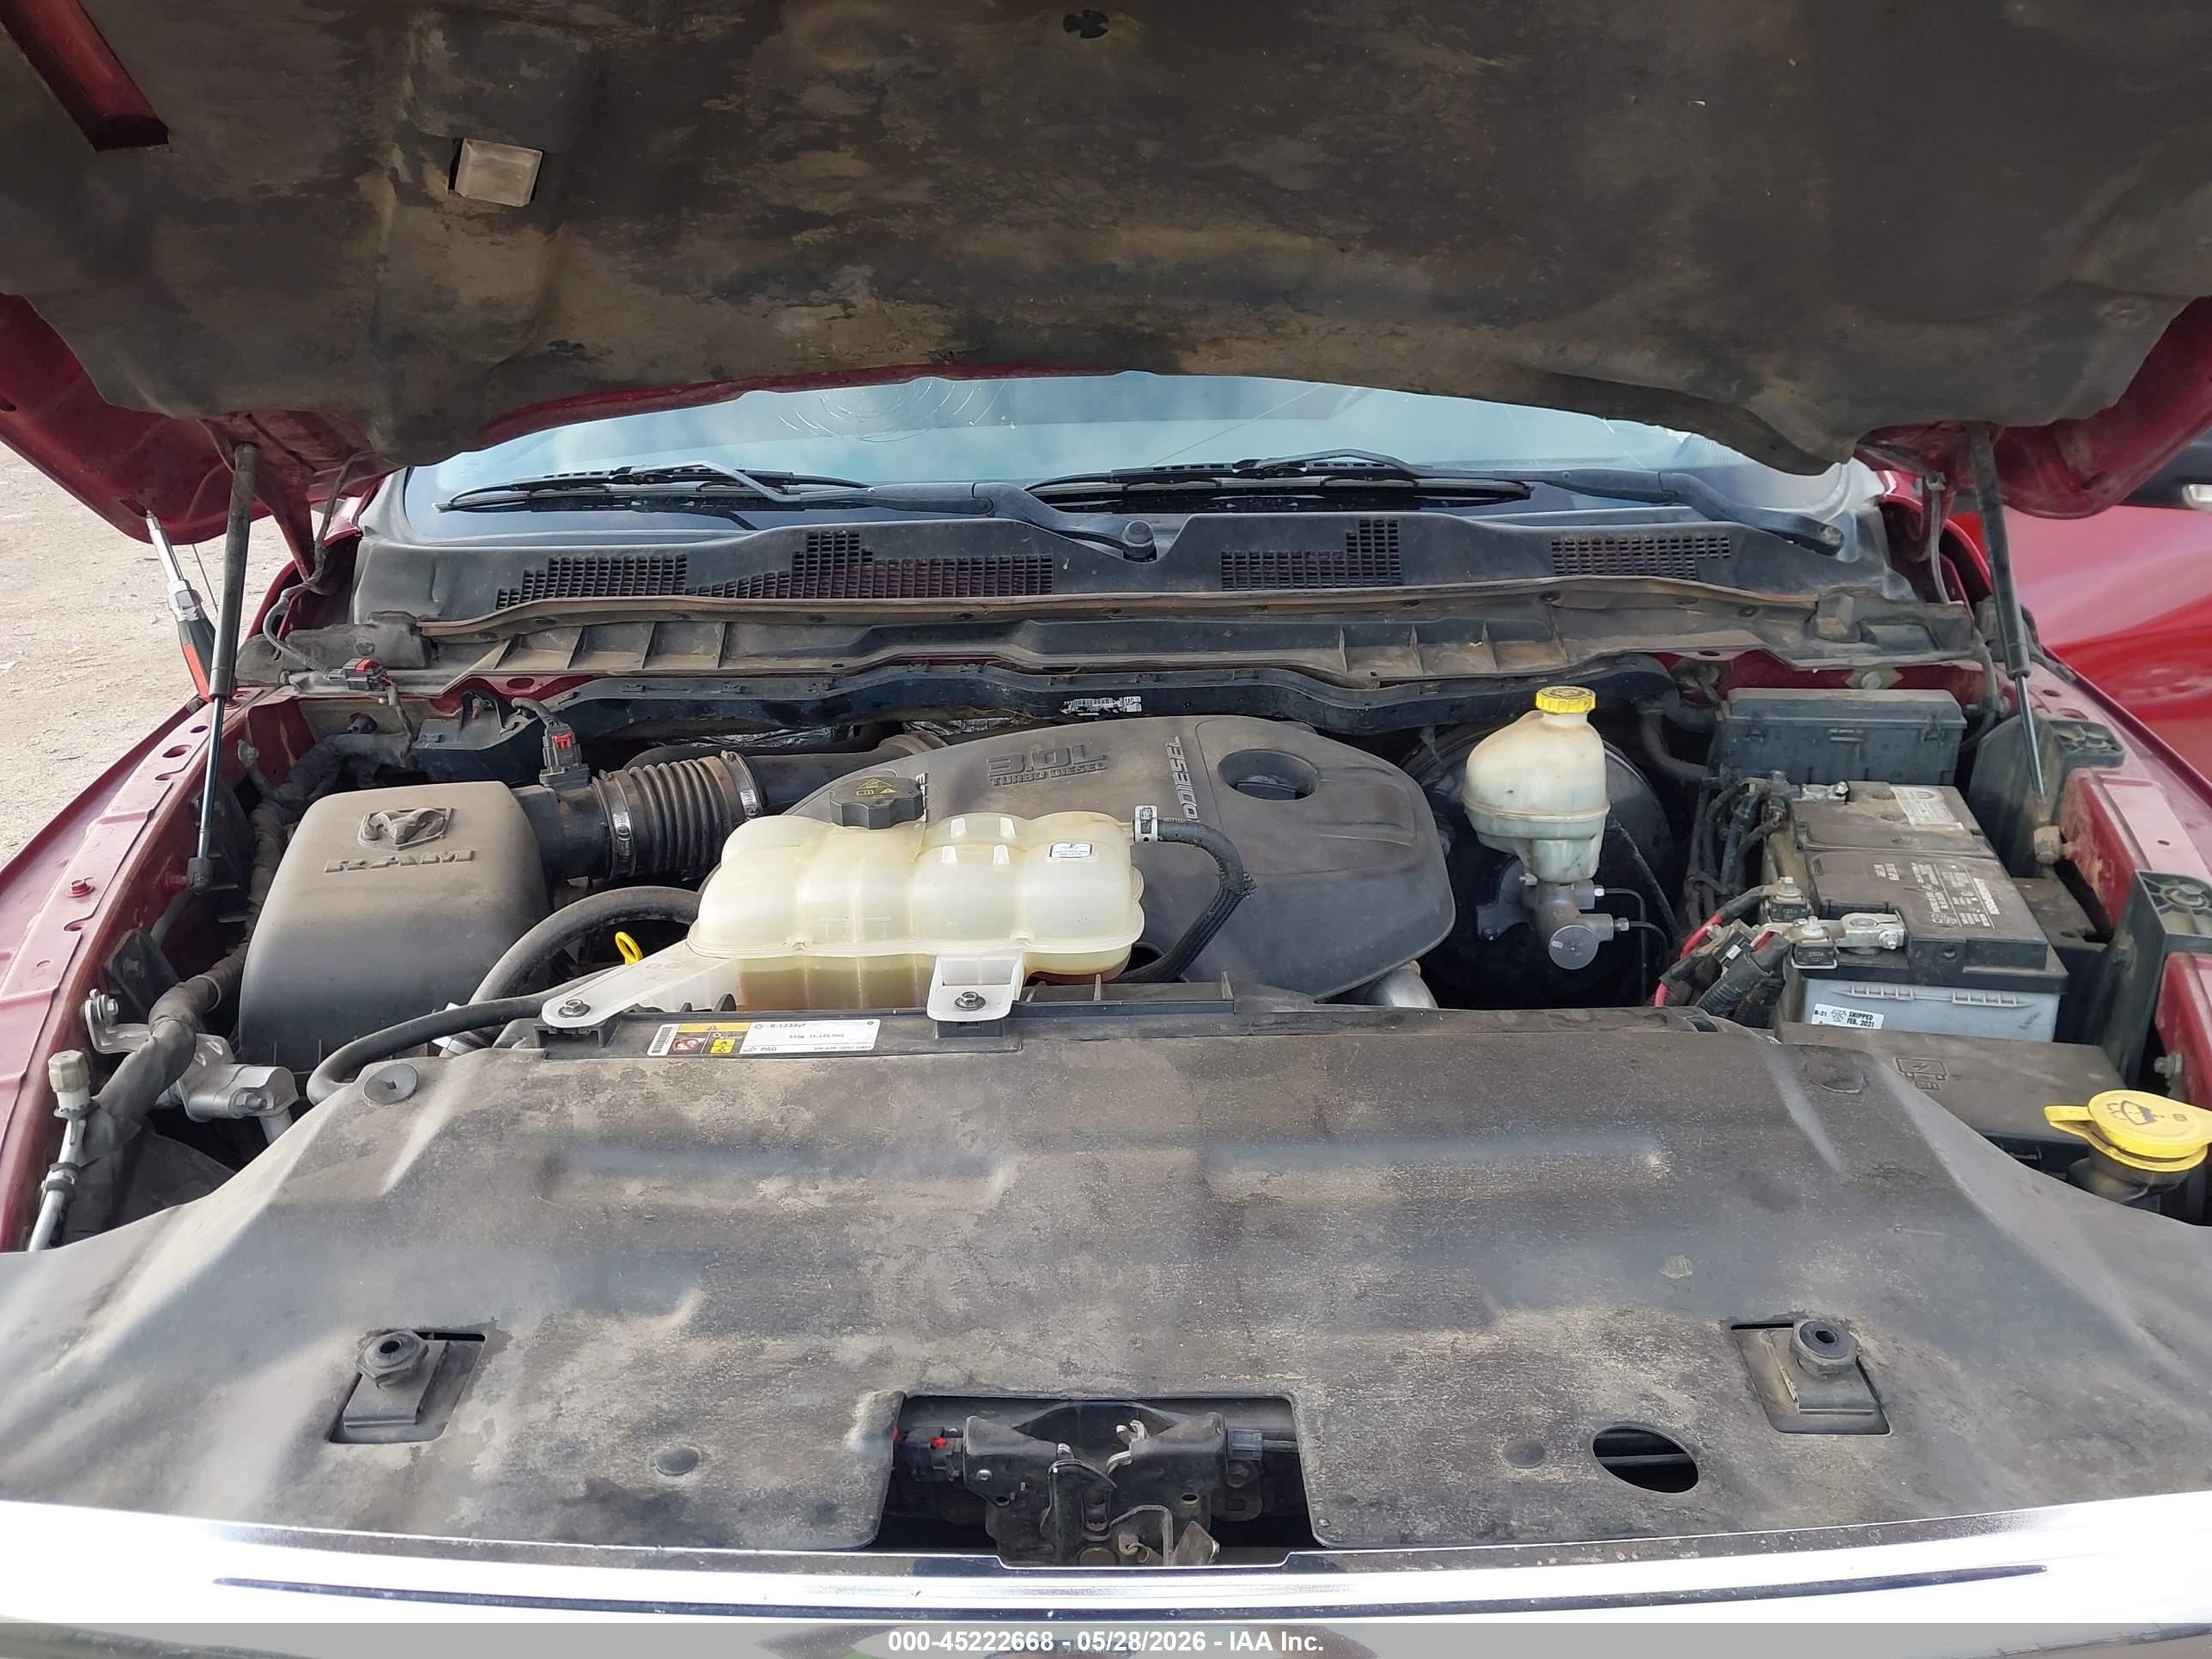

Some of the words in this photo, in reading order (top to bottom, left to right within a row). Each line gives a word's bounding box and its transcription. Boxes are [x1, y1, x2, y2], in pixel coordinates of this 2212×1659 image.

[987, 744, 1107, 777] 3.0L
[989, 771, 1047, 787] TURBO
[1049, 762, 1108, 779] DIESEL
[1164, 736, 1199, 821] ODIESEL
[324, 849, 476, 873] RAM
[1848, 1011, 1875, 1021] SHIPPED
[1859, 1019, 1875, 1028] 2021
